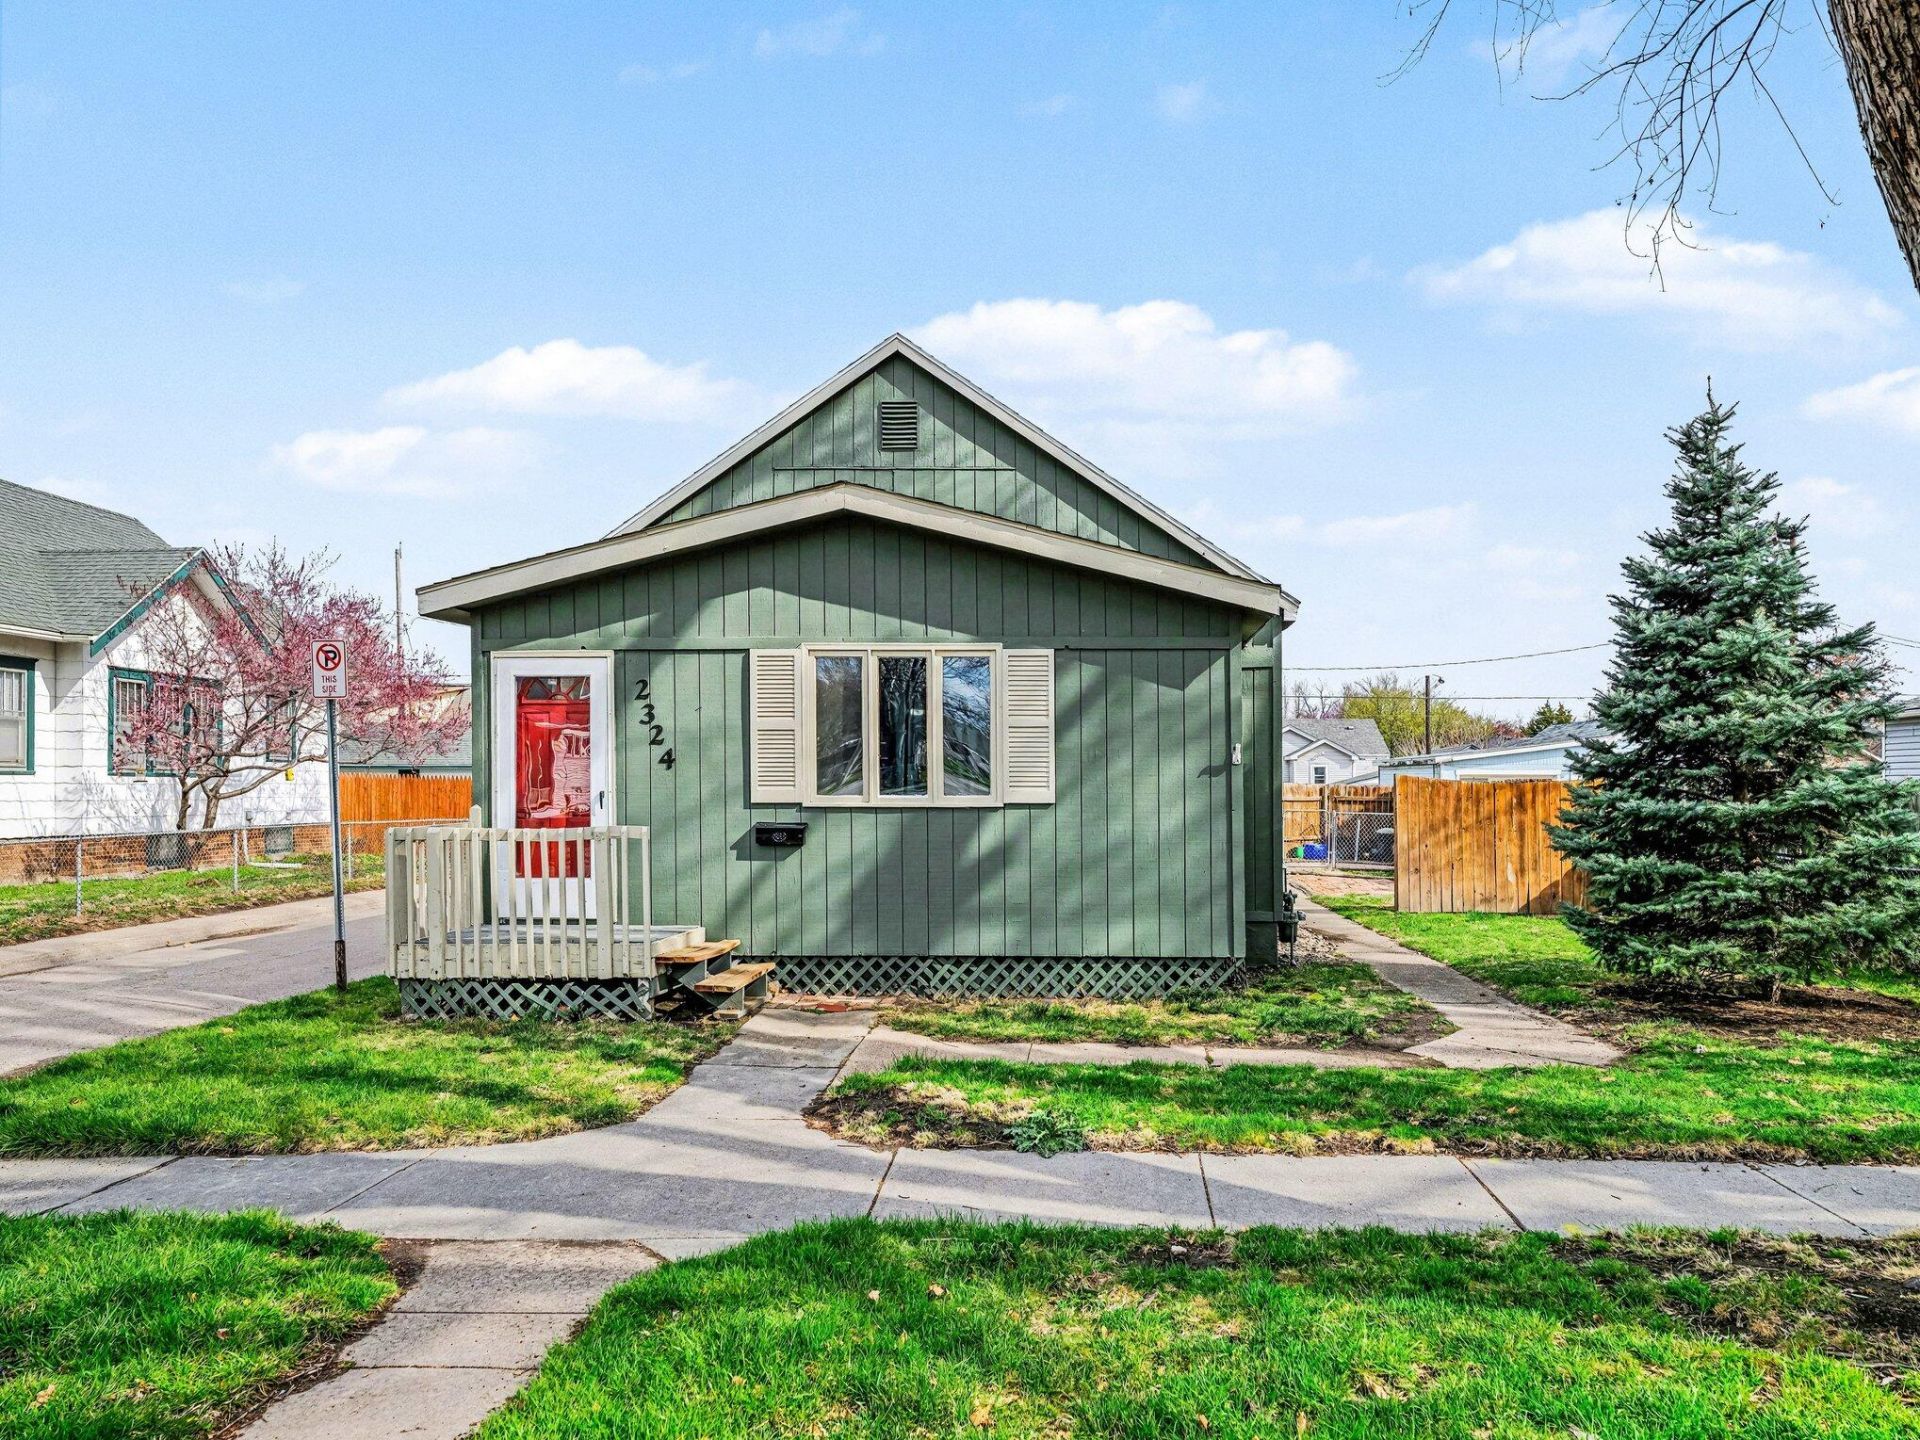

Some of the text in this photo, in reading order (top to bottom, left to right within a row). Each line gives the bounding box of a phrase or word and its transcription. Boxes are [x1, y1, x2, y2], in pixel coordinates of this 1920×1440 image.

[321, 675, 337, 683] THIS
[321, 685, 337, 693] SIDE
[634, 679, 676, 771] 2324
